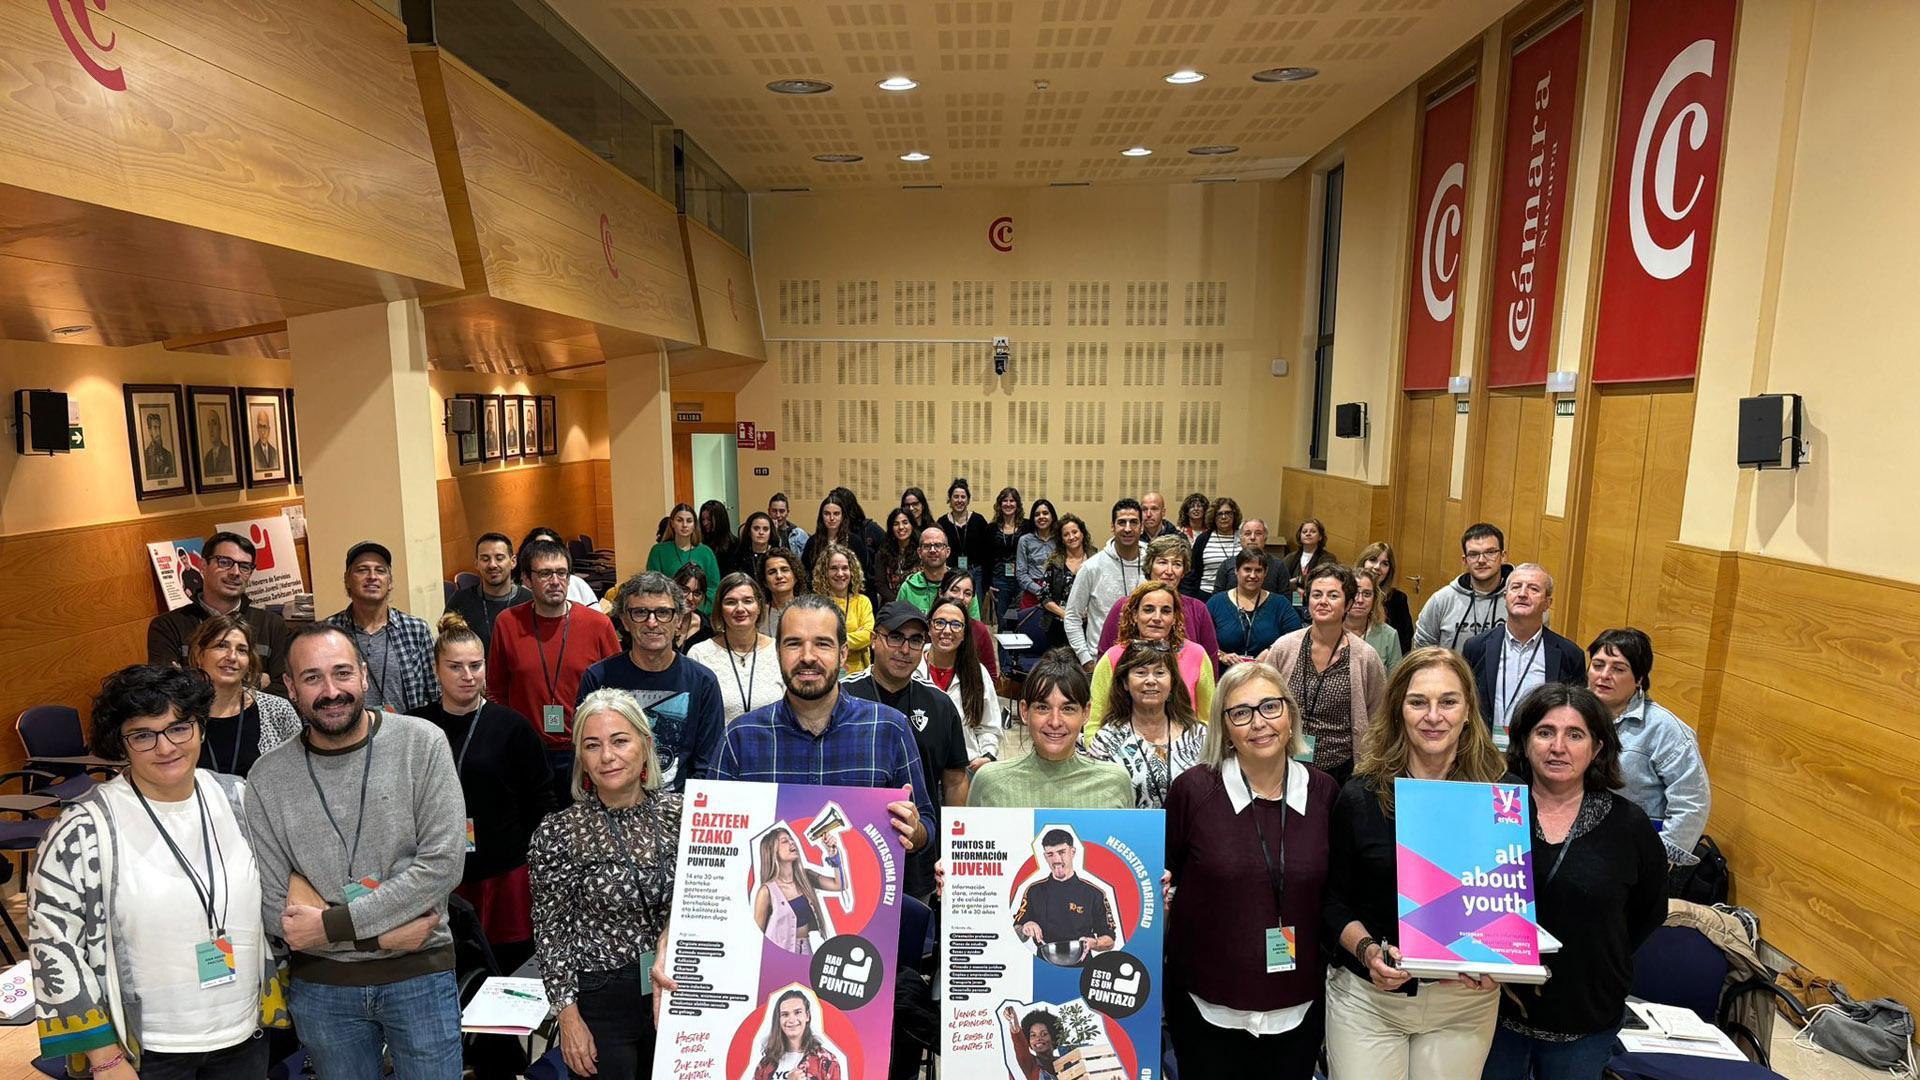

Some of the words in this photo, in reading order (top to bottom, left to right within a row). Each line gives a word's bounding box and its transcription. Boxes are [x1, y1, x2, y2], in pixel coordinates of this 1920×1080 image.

[1539, 142, 1558, 248] Navarra
[1508, 70, 1551, 351] Cámara
[691, 812, 750, 829] GAZTEEN
[1497, 816, 1520, 824] eryica
[690, 829, 733, 845] TZAKO
[951, 840, 984, 850] PUNTOS
[985, 840, 996, 849] DE
[688, 845, 739, 857] INFORMAZIO
[951, 850, 1008, 860] INFORMACIÓN
[1495, 844, 1526, 866] all
[687, 857, 726, 868] PUNTUAK
[863, 823, 897, 883] ANIZTASUNA
[882, 884, 897, 906] BIZI
[951, 862, 1004, 876] JUVENIL
[1105, 835, 1148, 879] NECESITAS
[1140, 878, 1155, 929] VARIEDAD
[1461, 866, 1527, 889] about
[1462, 892, 1528, 917] youth
[824, 953, 843, 967] HAU
[822, 964, 838, 976] BAI
[1092, 969, 1112, 980] ESTO
[818, 974, 865, 998] PUNTUA
[1090, 978, 1101, 988] ES
[1101, 980, 1112, 990] UN
[1087, 988, 1136, 1007] PUNTAZO
